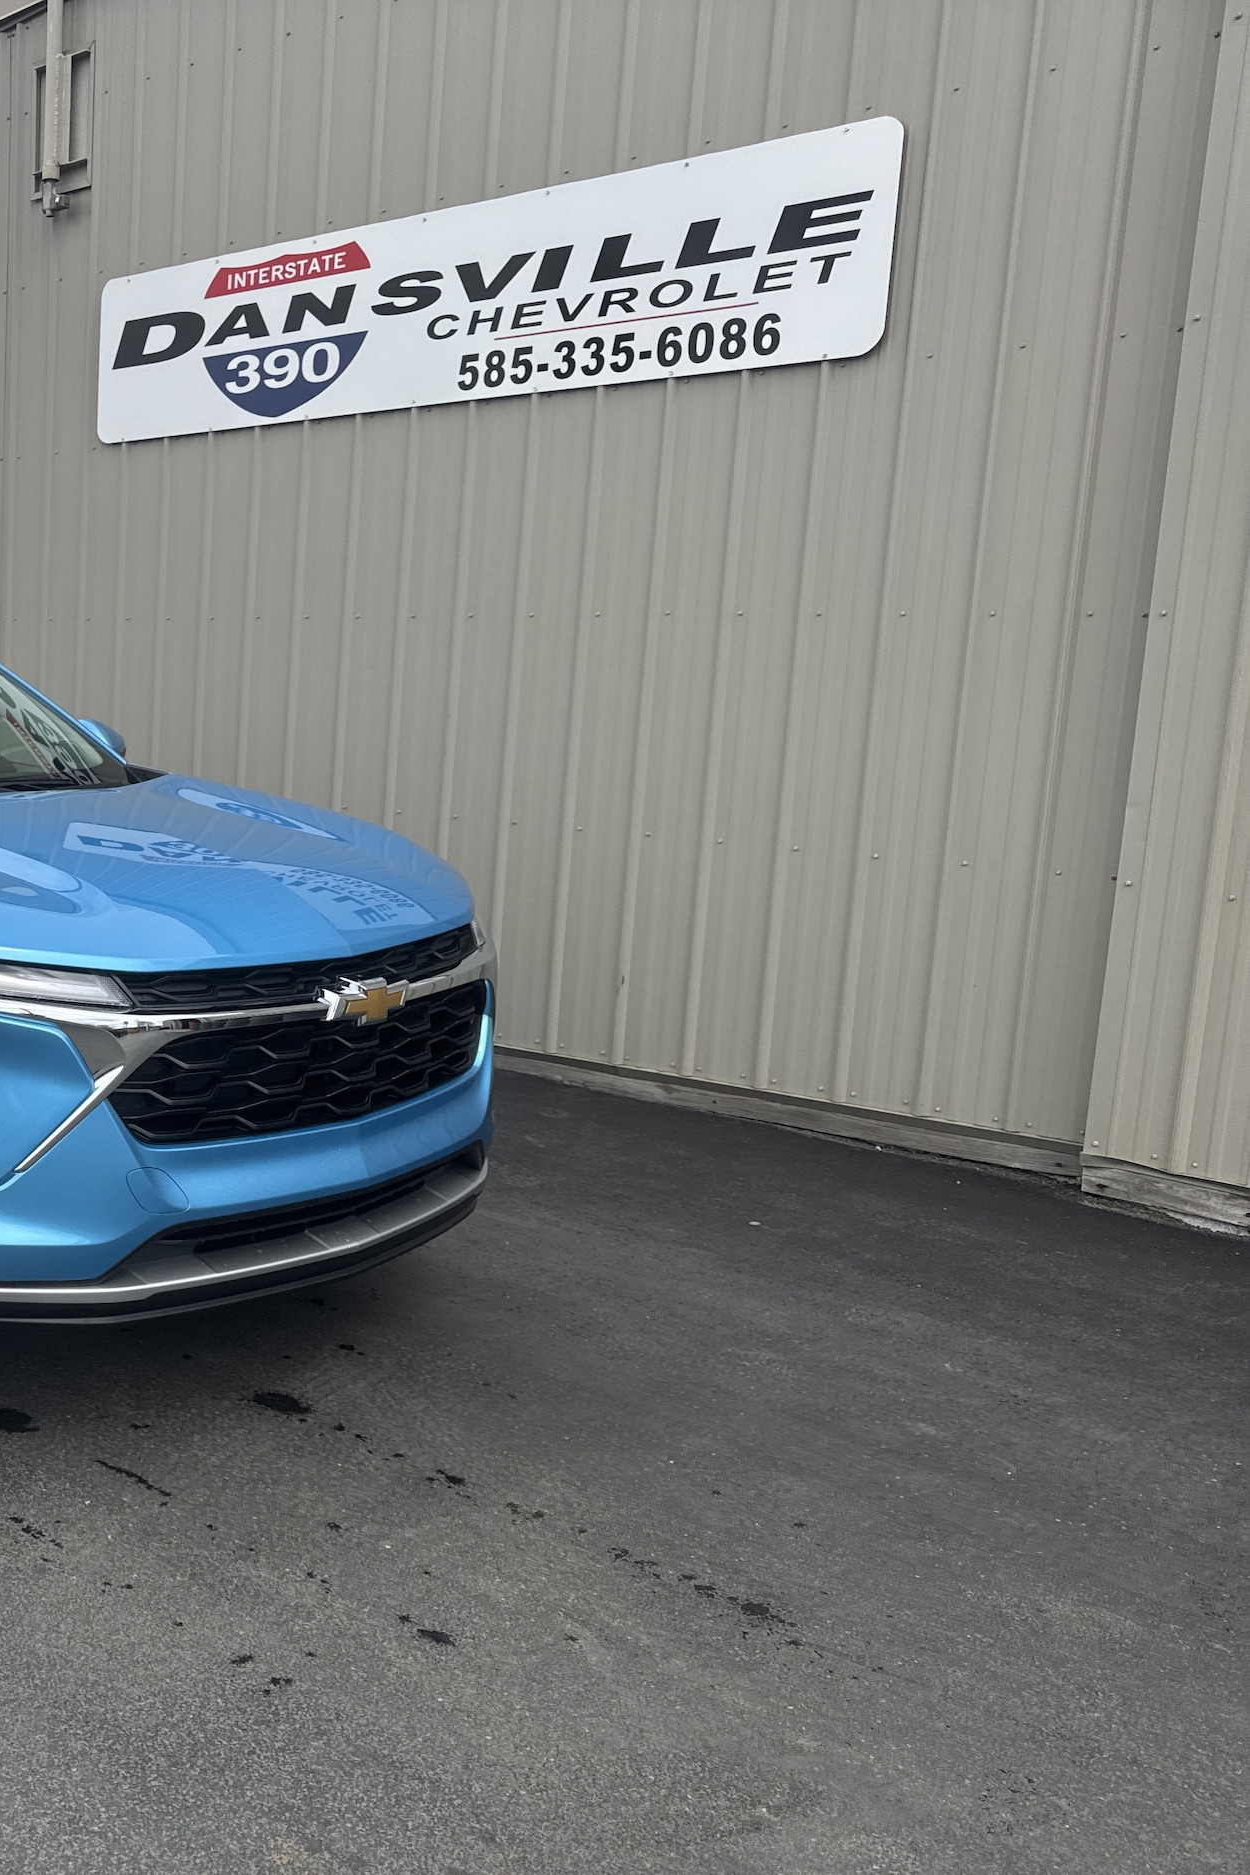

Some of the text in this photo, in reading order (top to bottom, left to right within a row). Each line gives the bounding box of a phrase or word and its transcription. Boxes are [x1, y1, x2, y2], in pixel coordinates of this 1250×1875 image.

[112, 189, 875, 370] DANSVILLE
[226, 251, 347, 291] INTERSTATE
[426, 251, 853, 341] CHEVROLET
[224, 341, 341, 395] 390
[457, 312, 782, 391] 585-335-6086
